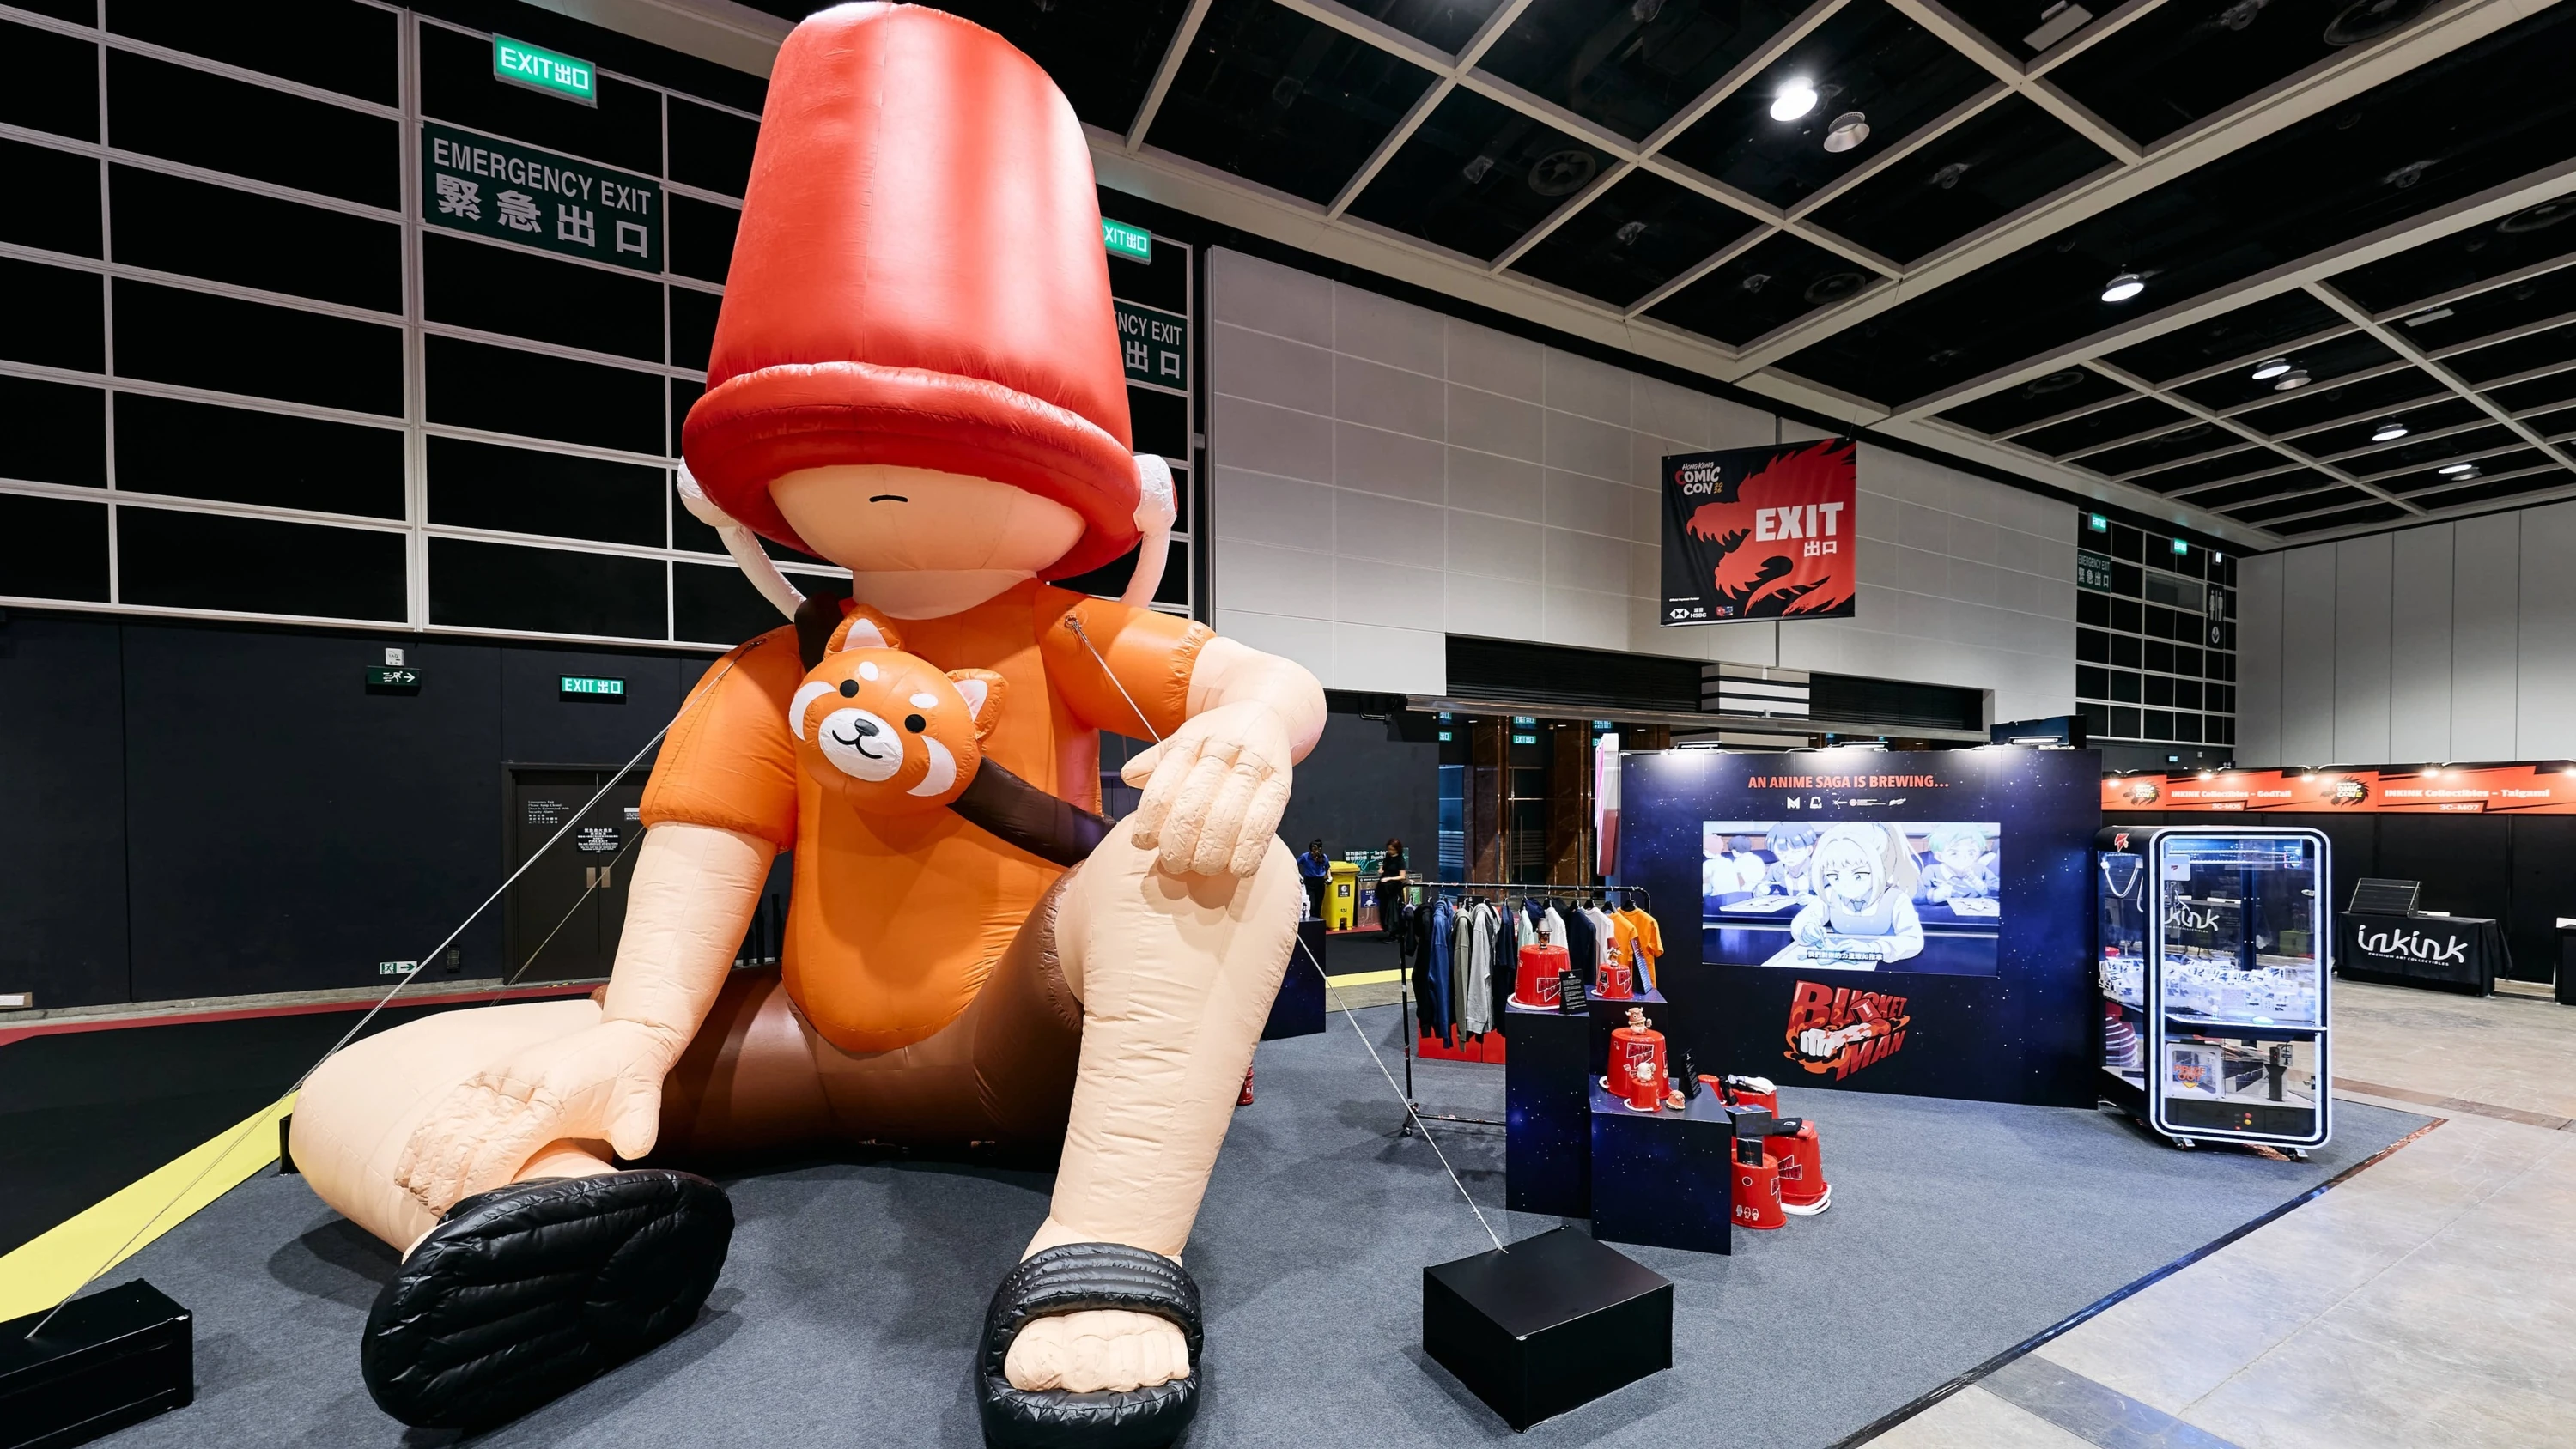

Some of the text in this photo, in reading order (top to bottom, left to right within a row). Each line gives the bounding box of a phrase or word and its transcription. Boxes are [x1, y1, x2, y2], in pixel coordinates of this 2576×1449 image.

[501, 46, 589, 90] EXIT 出口
[434, 137, 651, 215] EMERGENCY EXIT
[435, 173, 648, 258] 緊急出口
[1103, 224, 1147, 252] XIT 出口
[1151, 320, 1182, 345] EXIT
[1675, 466, 1721, 485] COMIC
[1683, 482, 1713, 495] CON
[1755, 501, 1844, 542] EXIT
[1804, 541, 1837, 557] 出口
[565, 678, 620, 694] EXIT 出口
[1748, 776, 1766, 788] AN
[1769, 776, 1813, 788] ANIME
[1815, 775, 1850, 788] SAGA
[1854, 775, 1866, 788] IS
[2358, 925, 2468, 963] inkink
[2407, 956, 2449, 967] COLLECTIBLES
[1836, 1030, 1906, 1082] MAN
[2174, 1064, 2206, 1074] PRIZE
[2178, 1072, 2201, 1081] OUT
